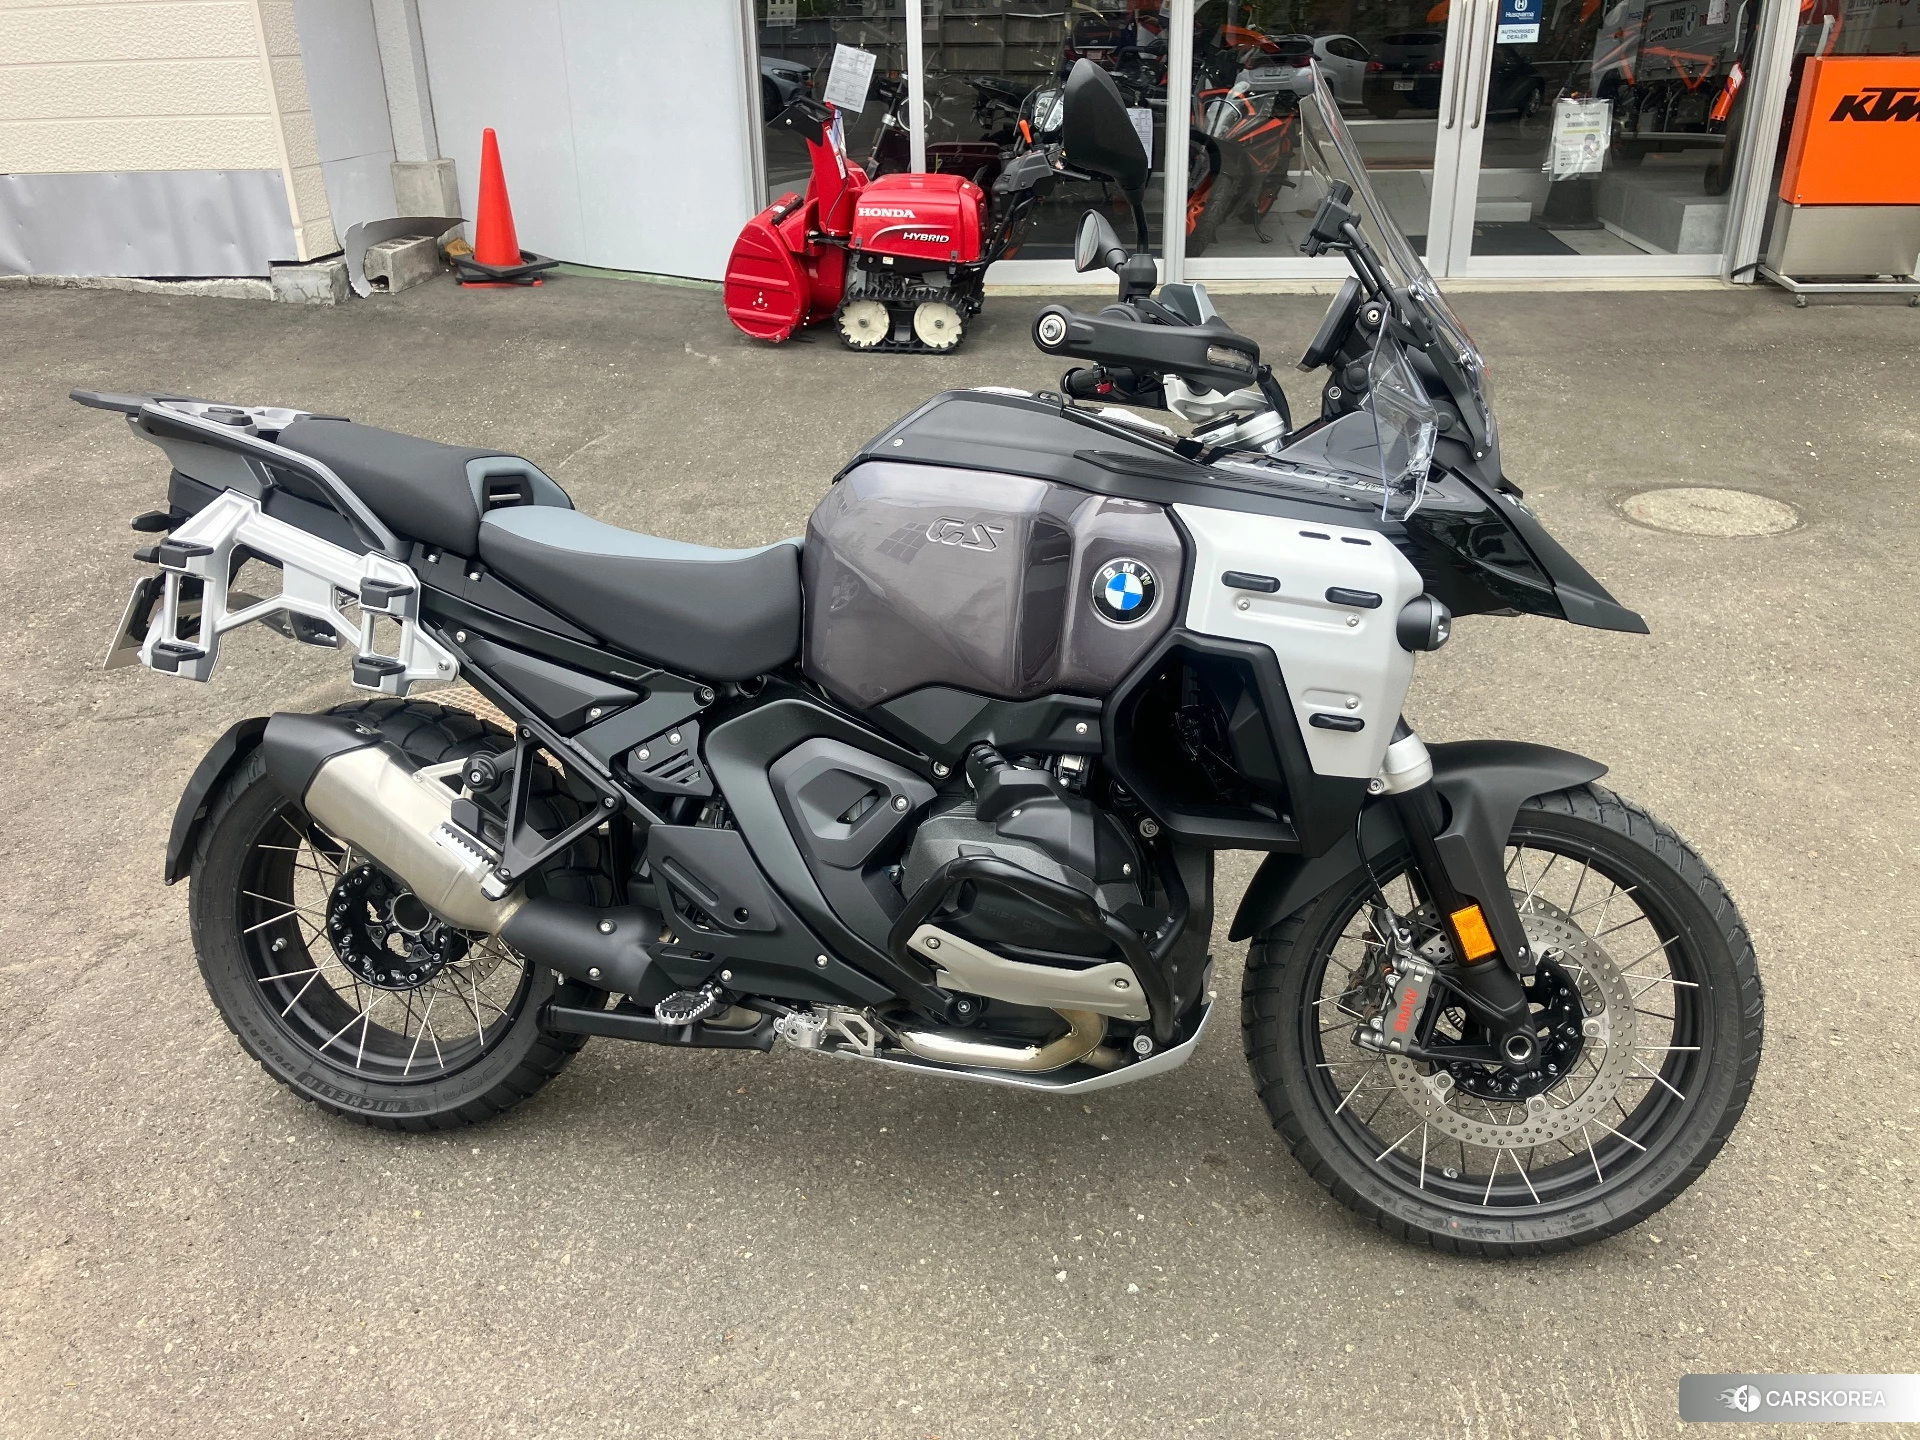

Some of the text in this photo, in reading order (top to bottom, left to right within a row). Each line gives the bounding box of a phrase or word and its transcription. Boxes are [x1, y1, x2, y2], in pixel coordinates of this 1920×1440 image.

[857, 207, 916, 219] HONDA
[902, 232, 950, 243] HYBRID
[926, 516, 1004, 551] GS
[1102, 562, 1153, 586] BMW
[1393, 987, 1418, 1032] BMW
[258, 1039, 296, 1072] 170/60
[301, 1075, 400, 1113] MICHELIN
